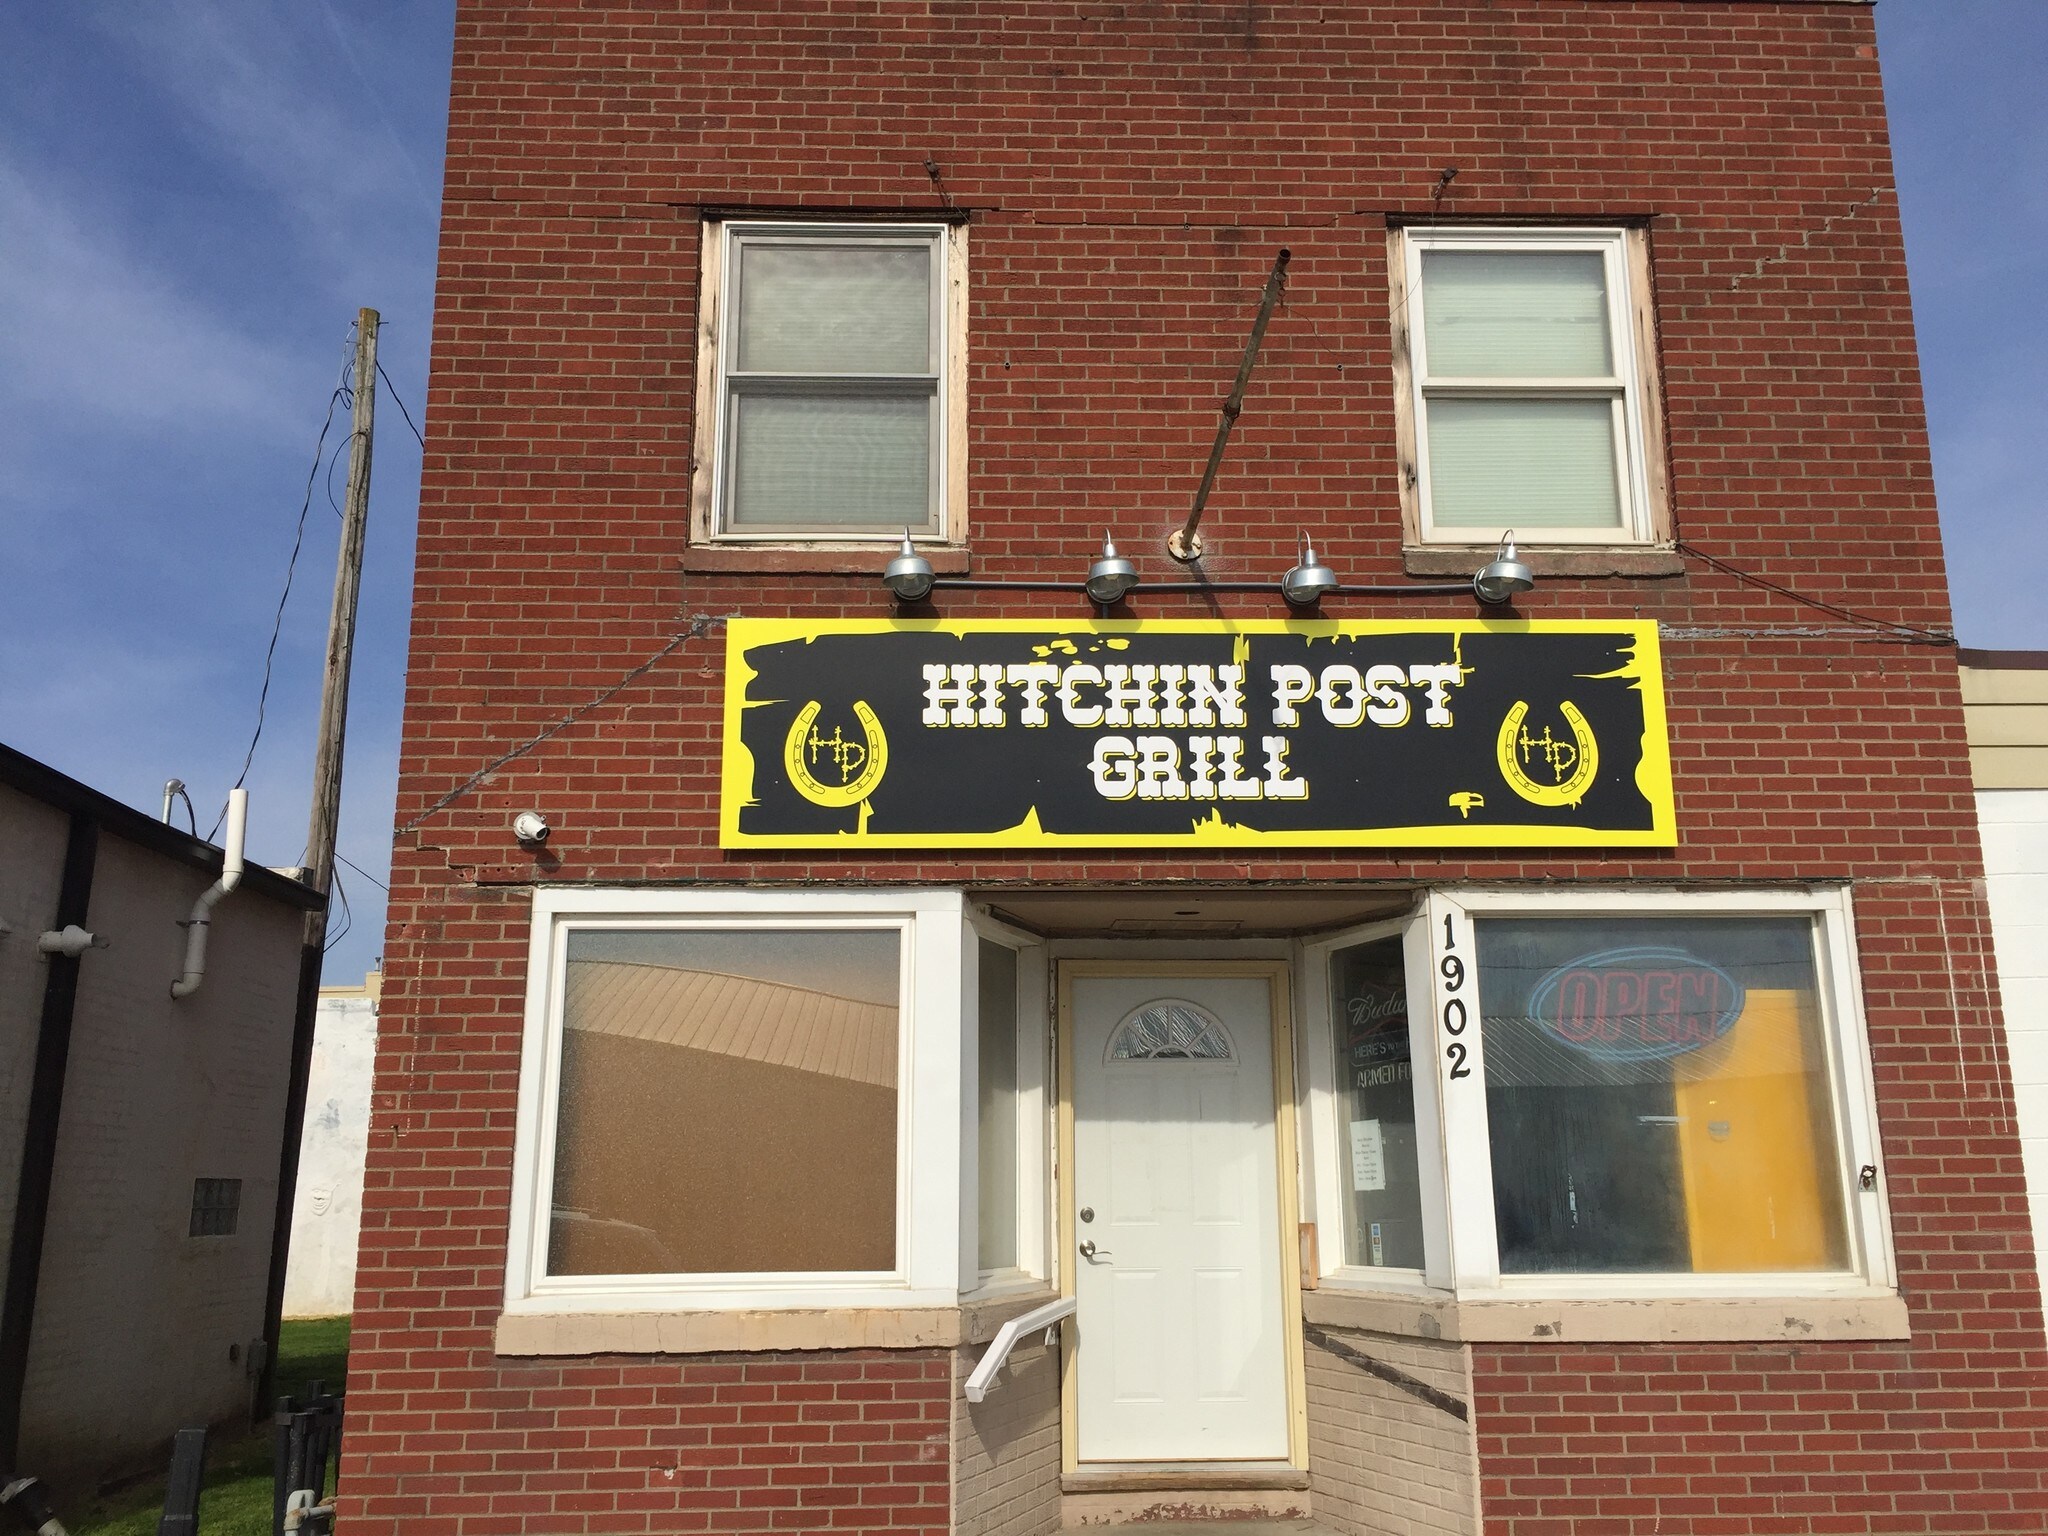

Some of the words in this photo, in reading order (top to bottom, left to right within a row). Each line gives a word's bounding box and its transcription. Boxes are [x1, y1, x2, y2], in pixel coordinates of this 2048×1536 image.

[922, 663, 1247, 728] HITCHIN
[1270, 663, 1464, 728] POST
[1087, 735, 1309, 800] GRILL
[1348, 992, 1407, 1026] Budw
[1440, 912, 1471, 1081] 1902
[1558, 972, 1719, 1043] OPEN
[1354, 1041, 1387, 1059] HERE'S
[1357, 1064, 1395, 1089] ARMED
